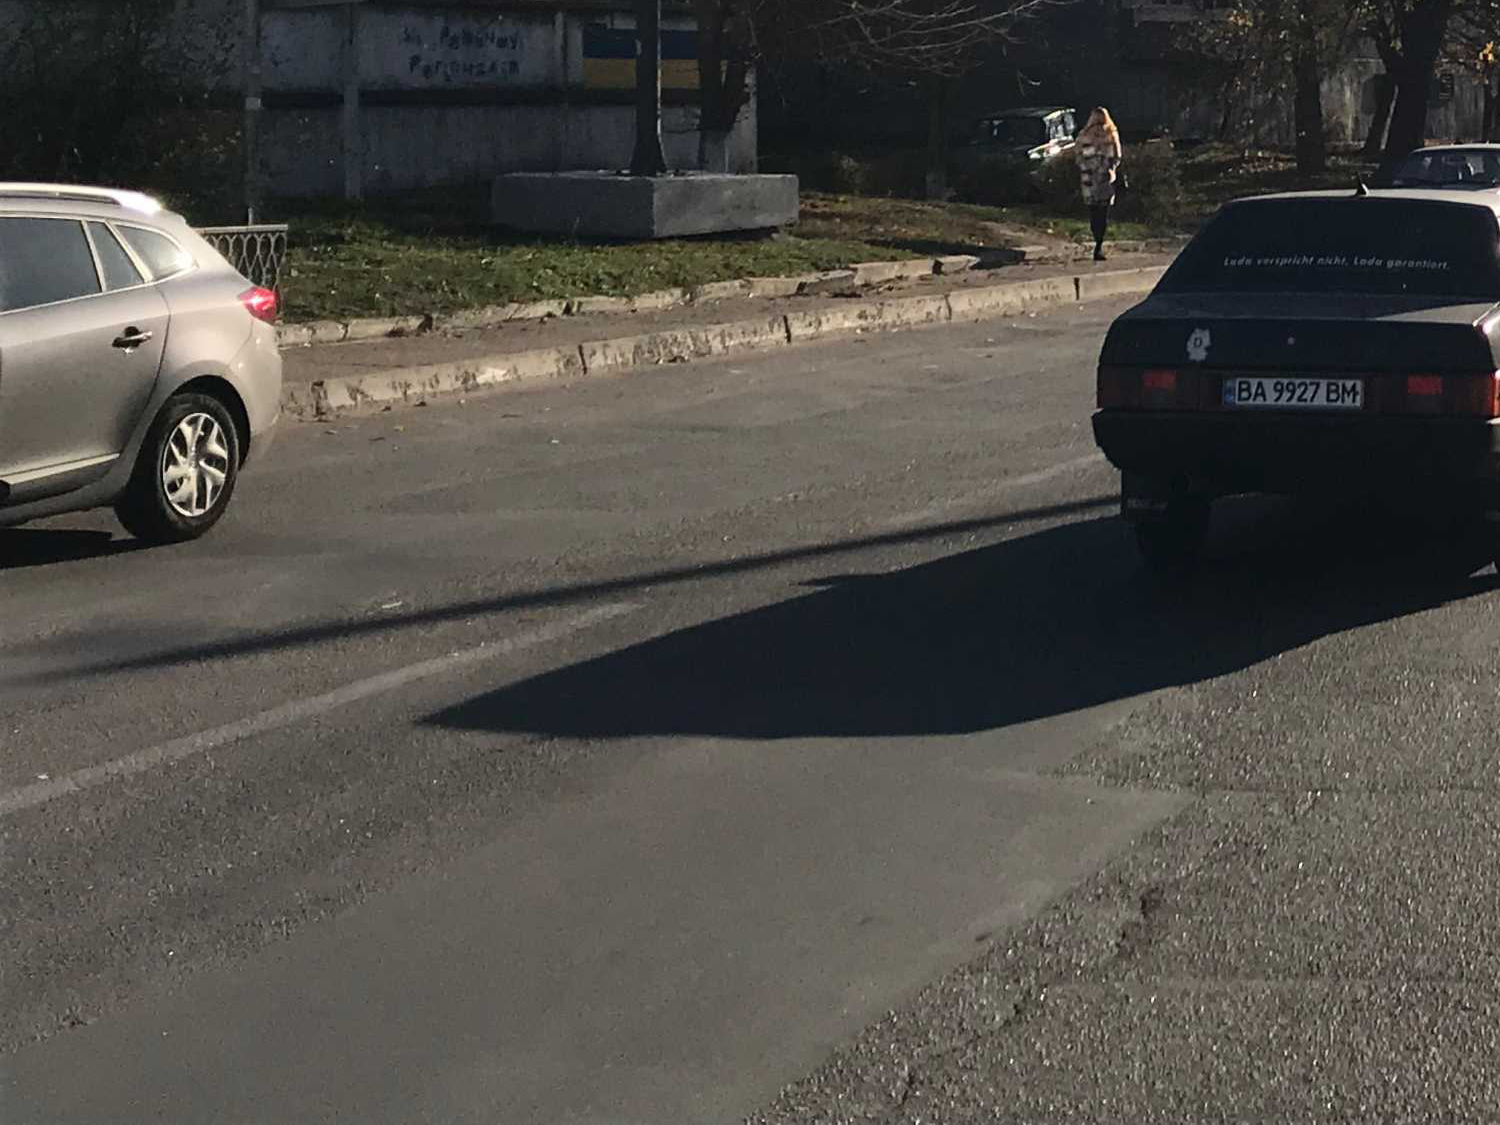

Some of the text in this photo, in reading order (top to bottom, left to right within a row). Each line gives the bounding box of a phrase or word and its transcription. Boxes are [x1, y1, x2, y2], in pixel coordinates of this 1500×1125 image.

[1256, 254, 1314, 267] verspricht
[1353, 255, 1383, 266] Lada
[1237, 380, 1359, 404] BA 9927 BM
